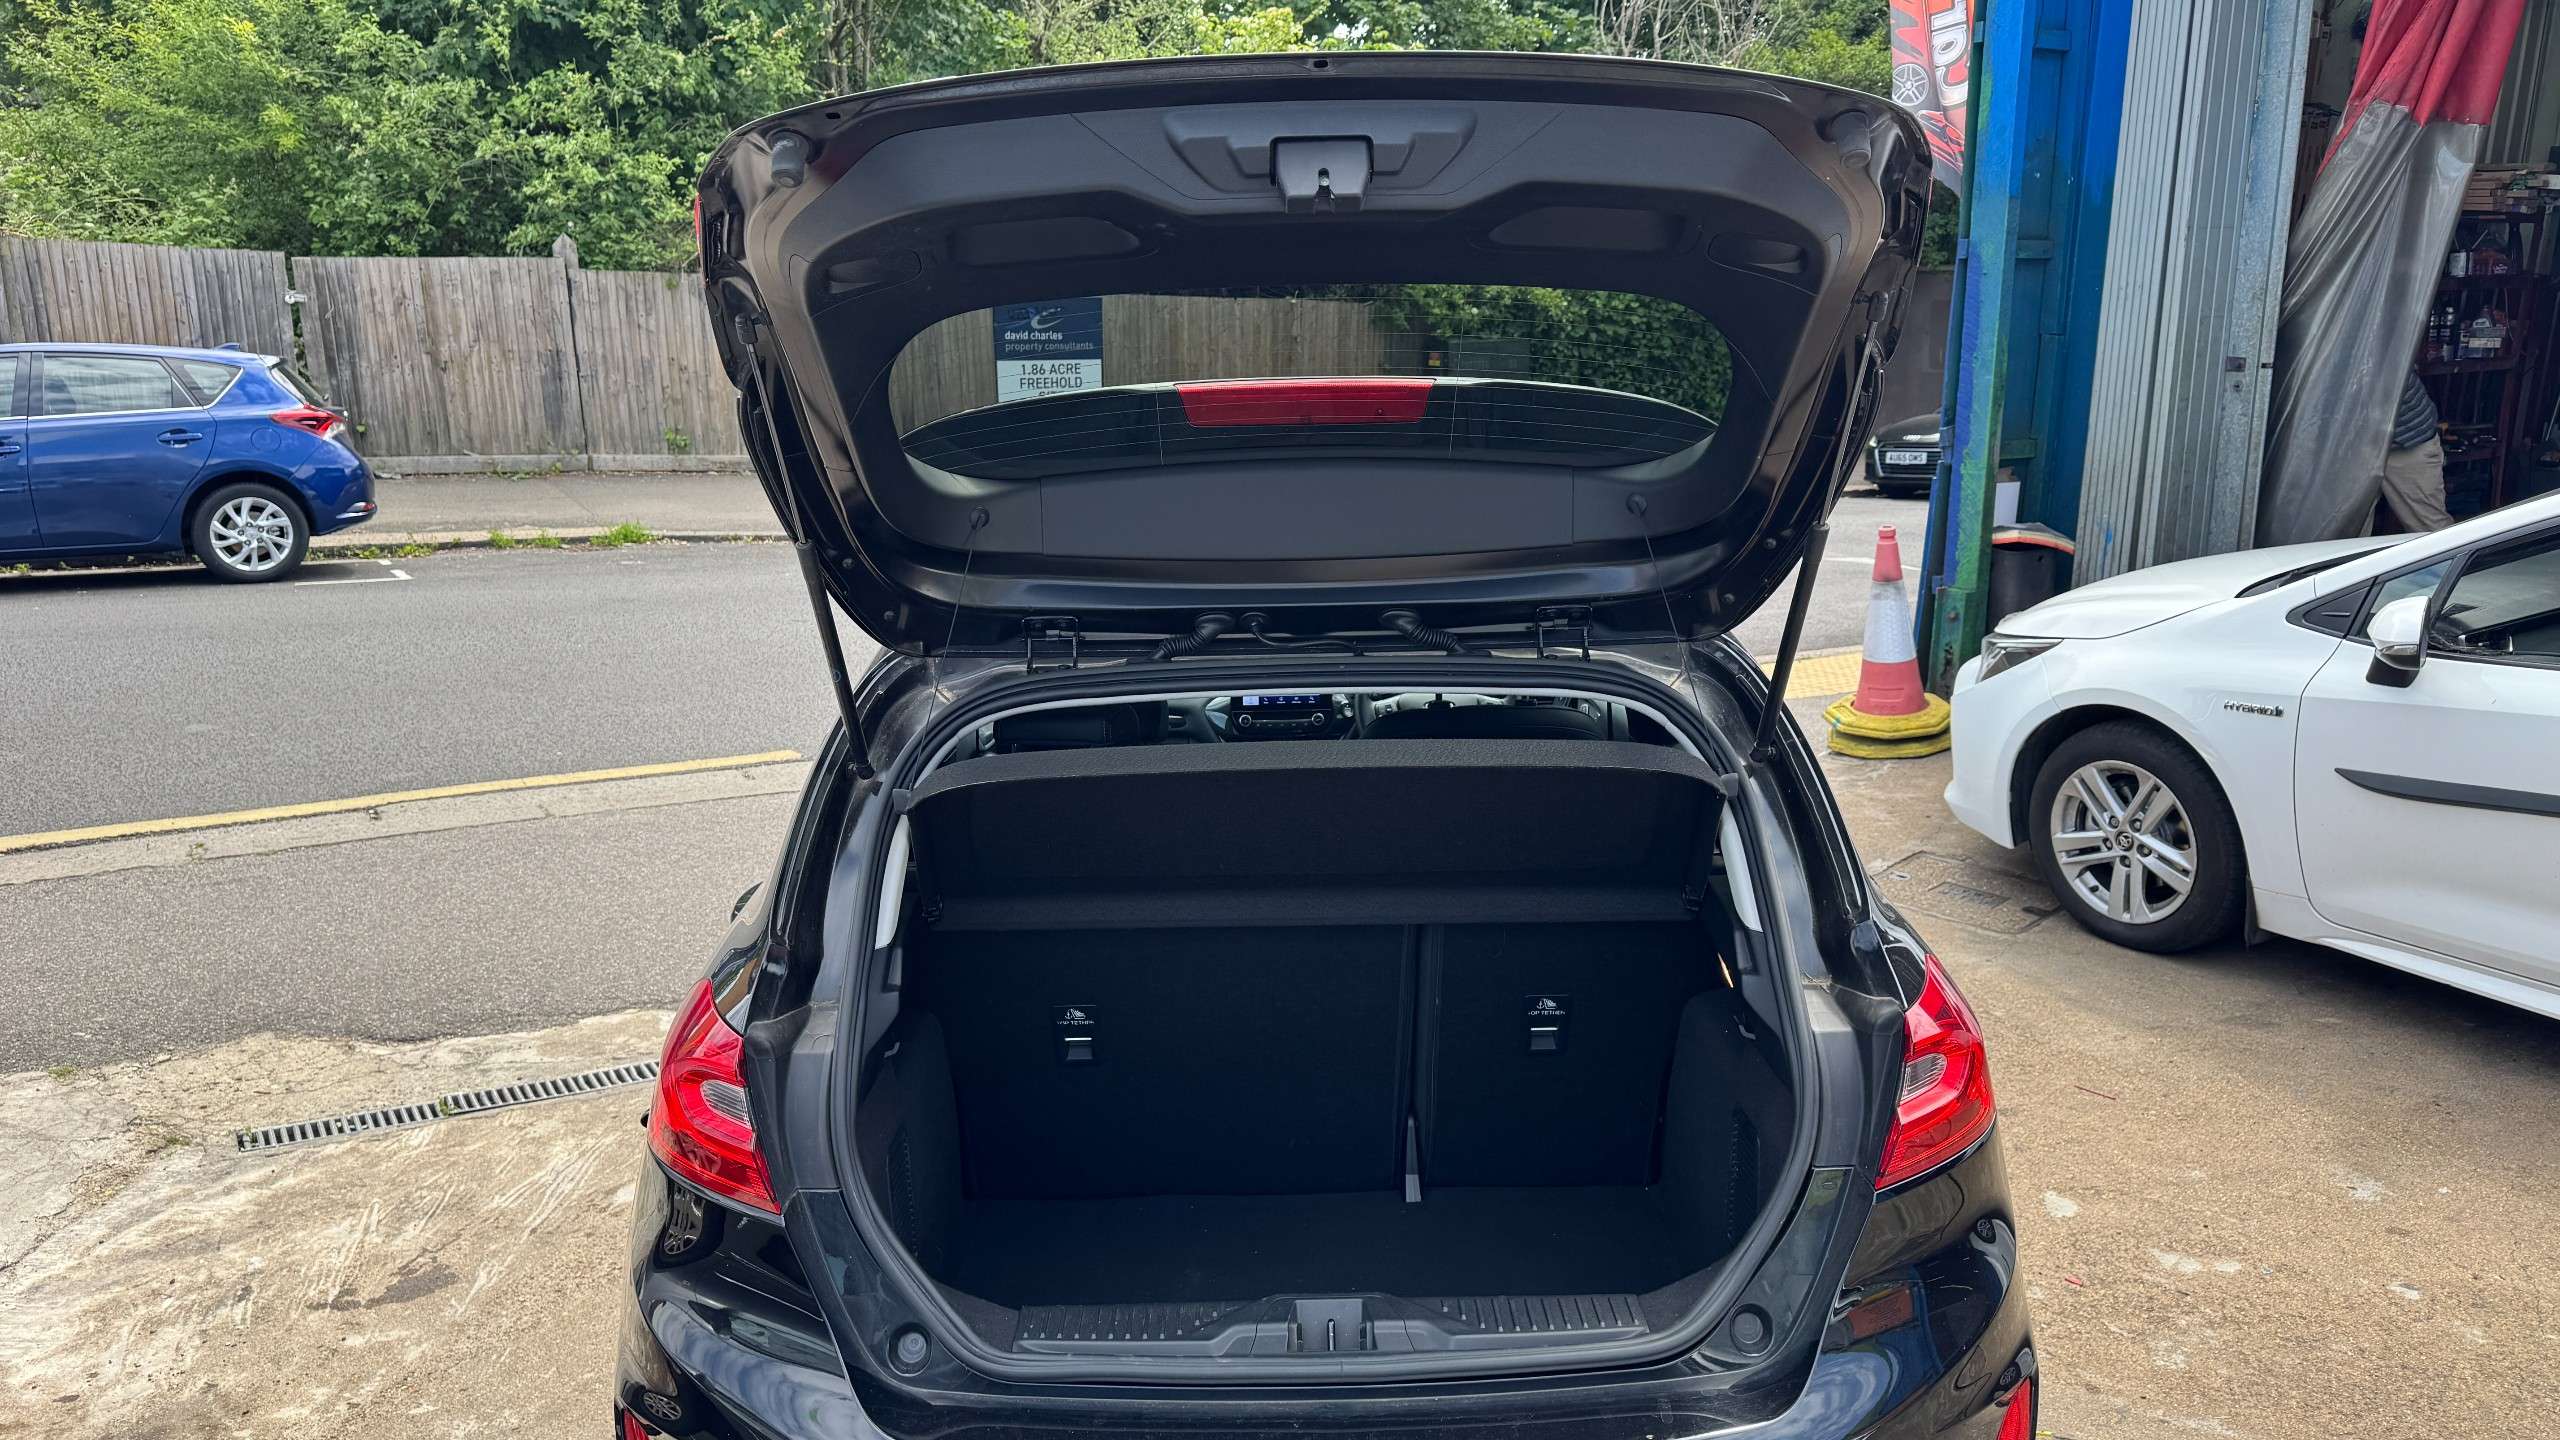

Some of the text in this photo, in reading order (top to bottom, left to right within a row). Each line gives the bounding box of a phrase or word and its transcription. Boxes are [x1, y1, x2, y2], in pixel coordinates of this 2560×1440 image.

[1004, 330, 1063, 340] david charles
[1005, 341, 1094, 352] property consultants
[1021, 362, 1082, 376] 1.86 ACRE
[1019, 376, 1083, 389] FREEHOLD
